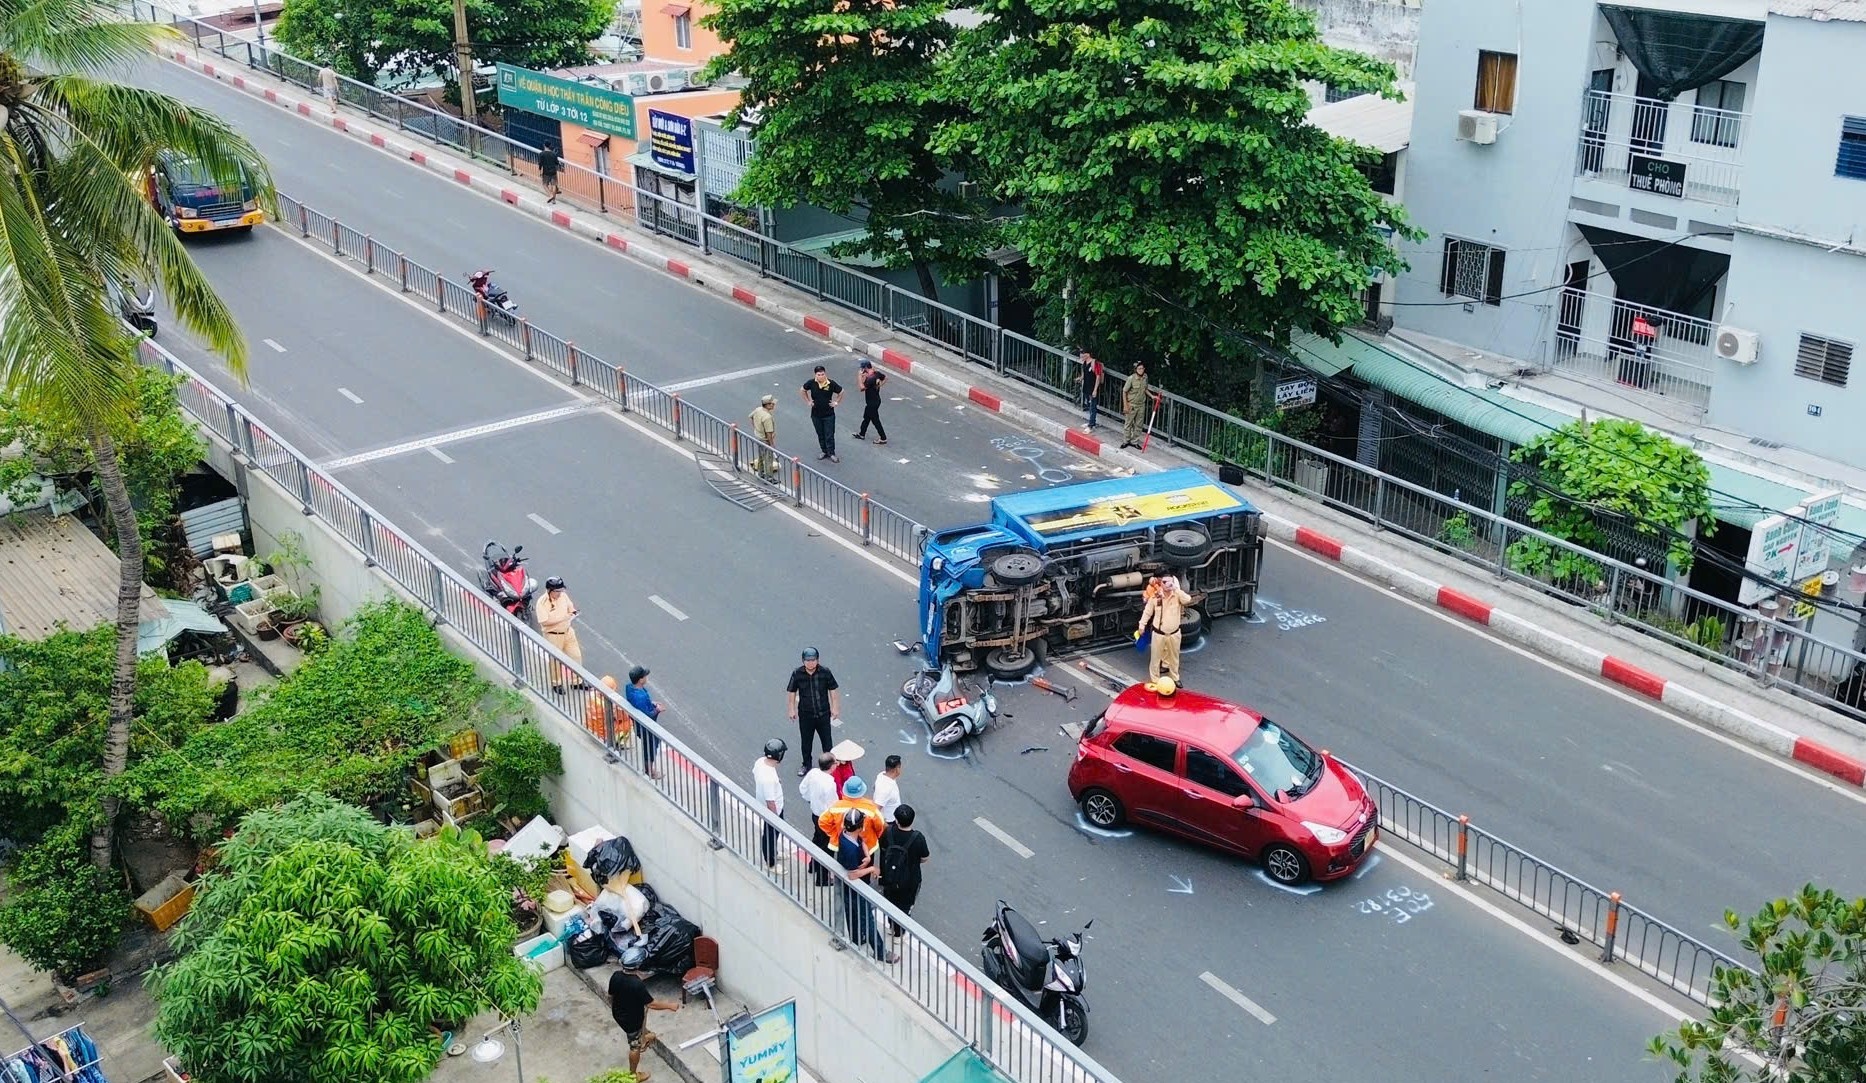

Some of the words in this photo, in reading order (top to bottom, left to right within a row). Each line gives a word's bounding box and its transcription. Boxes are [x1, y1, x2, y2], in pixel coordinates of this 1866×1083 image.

[536, 97, 545, 111] TỪ
[547, 101, 559, 114] LỚP
[561, 106, 566, 116] 3
[567, 106, 578, 120] TỚI
[580, 111, 588, 122] 12
[595, 94, 614, 112] CÔNG
[1647, 161, 1670, 174] CHO
[1632, 173, 1653, 190] THUÊ
[1653, 176, 1682, 196] PHÒNG
[739, 1040, 787, 1068] YUMMY
